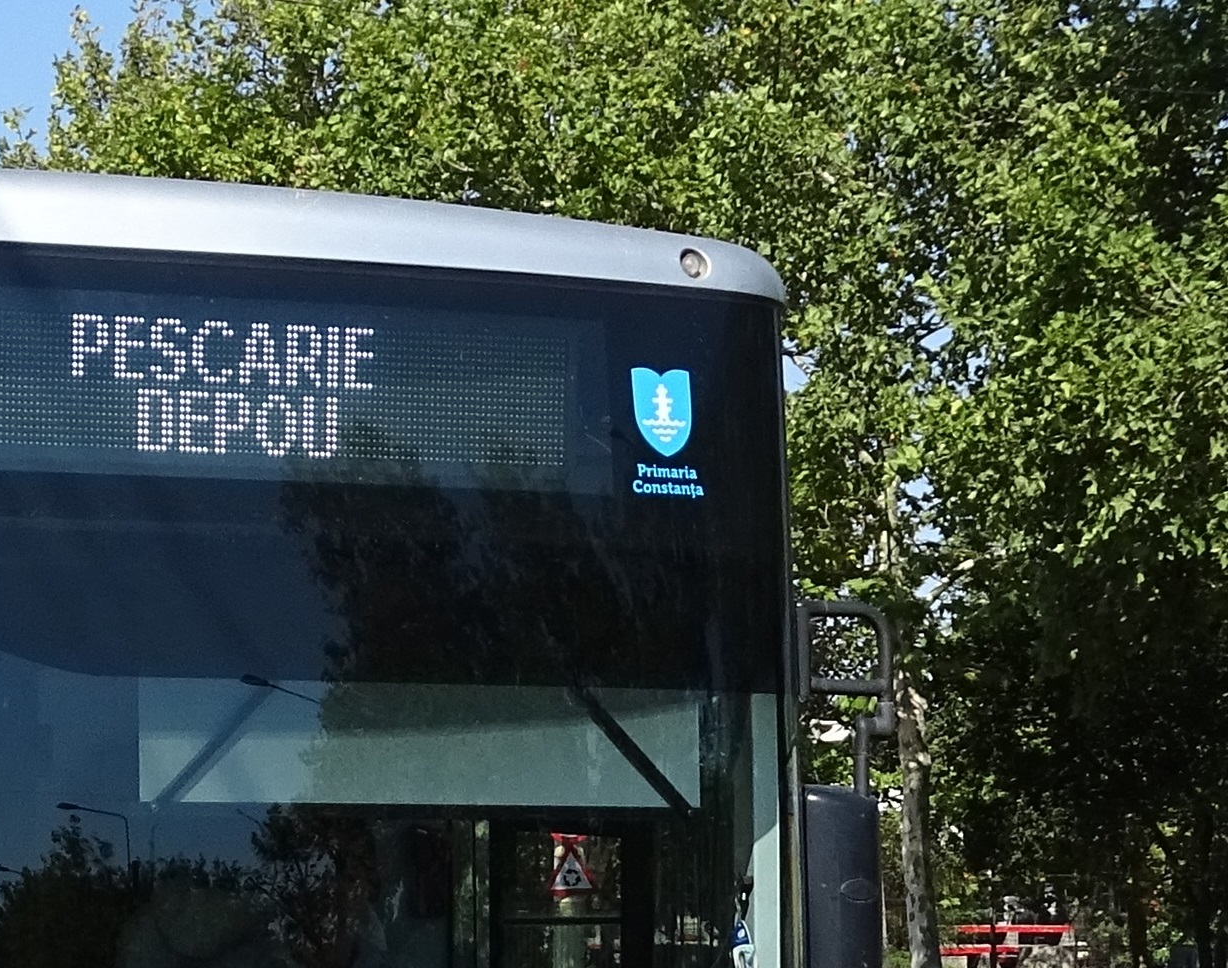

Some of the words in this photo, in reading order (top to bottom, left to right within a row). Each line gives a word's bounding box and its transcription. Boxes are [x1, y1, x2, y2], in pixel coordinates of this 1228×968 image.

[72, 313, 375, 389] PESCARIE
[137, 388, 338, 458] DEPOU
[636, 463, 698, 480] Primaria
